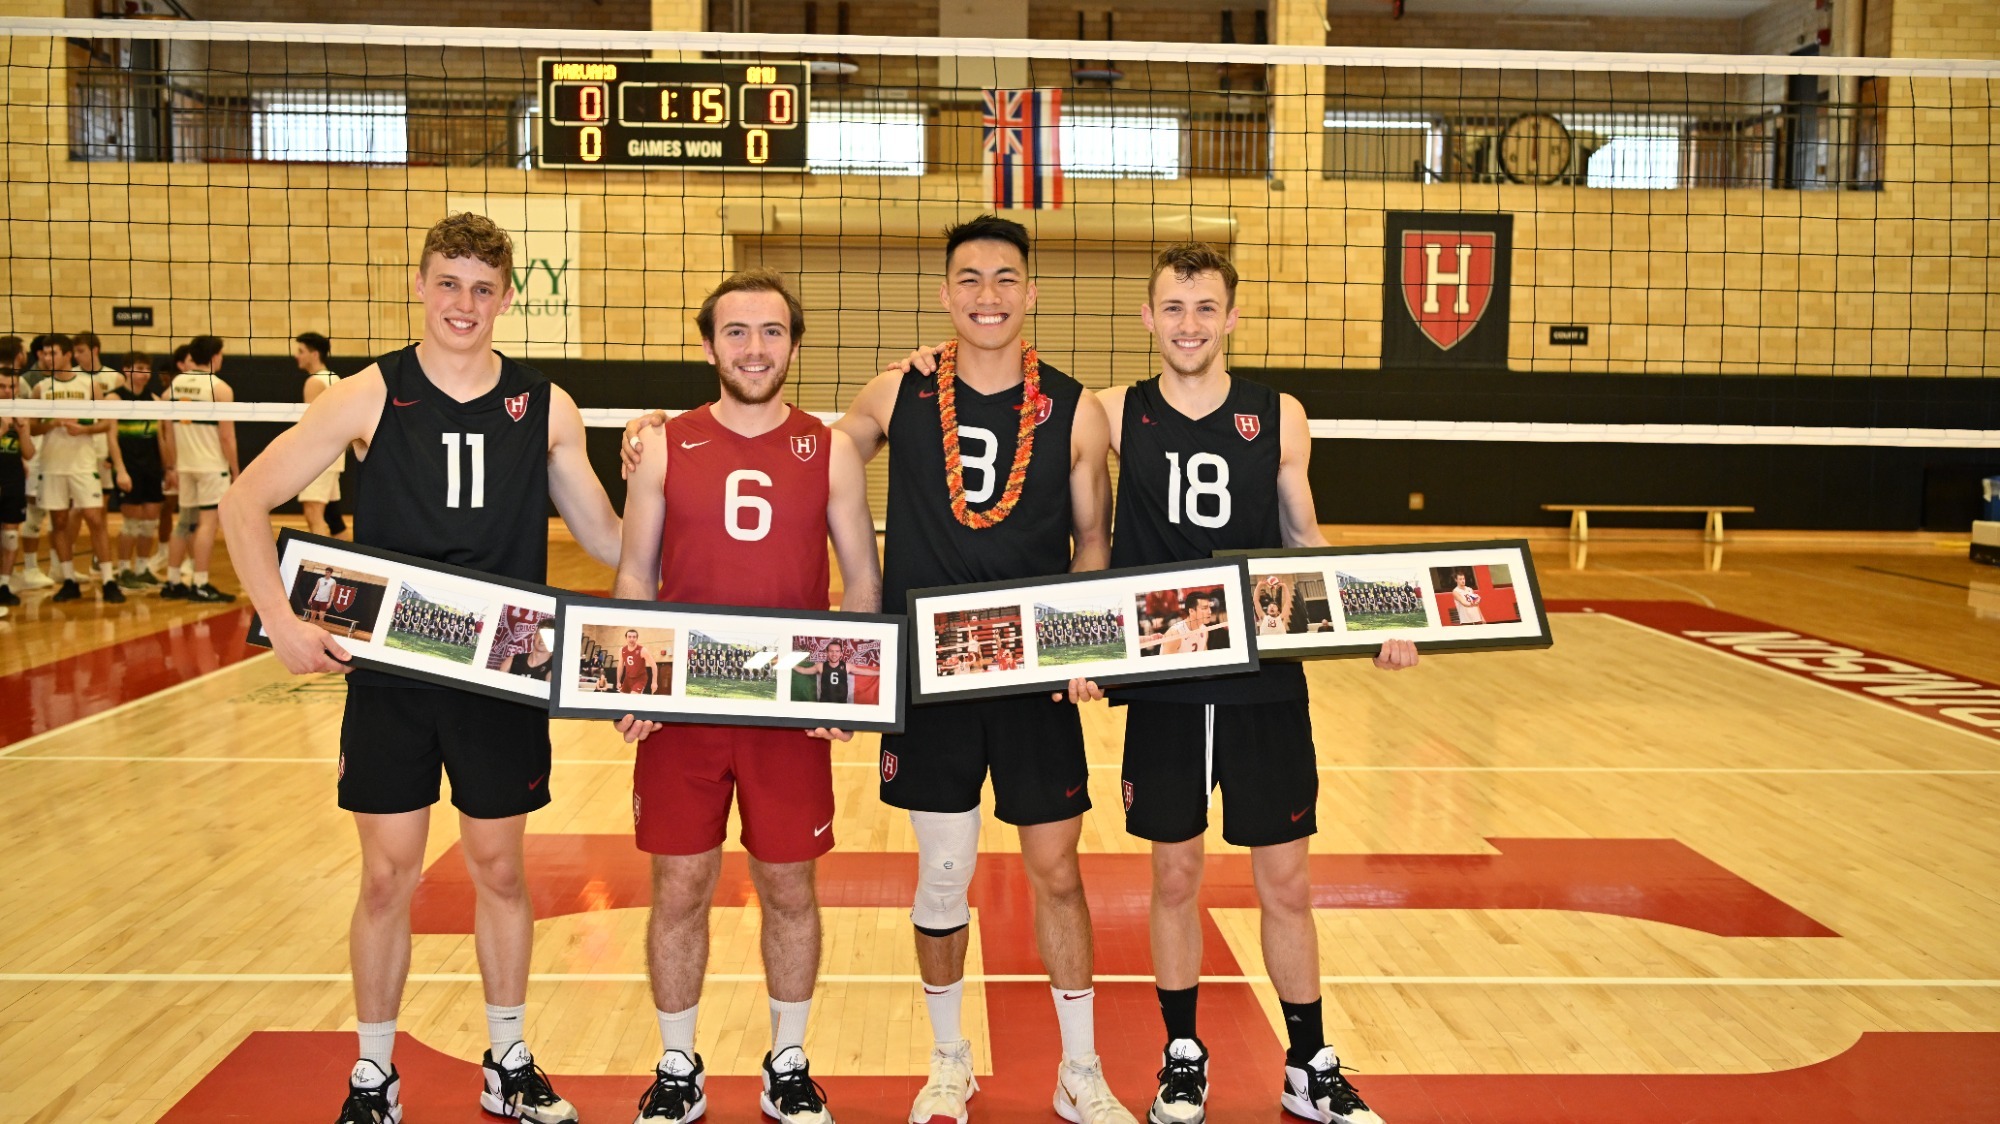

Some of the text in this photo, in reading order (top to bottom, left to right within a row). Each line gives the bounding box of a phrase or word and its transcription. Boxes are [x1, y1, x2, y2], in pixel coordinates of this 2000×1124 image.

[580, 86, 601, 121] 0
[661, 88, 723, 123] 1:15
[769, 89, 791, 123] 0
[580, 127, 602, 161] 0
[628, 139, 722, 157] GAMES WON
[747, 129, 768, 163] 0
[511, 258, 572, 295] VY
[1423, 243, 1472, 314] H
[501, 298, 572, 316] AGUE
[511, 396, 524, 413] H
[1240, 417, 1255, 432] H
[797, 438, 811, 453] H
[442, 432, 484, 508] 11
[724, 469, 773, 541] 6
[1165, 451, 1231, 528] 18
[515, 624, 536, 633] CRIMS
[830, 672, 839, 685] 6
